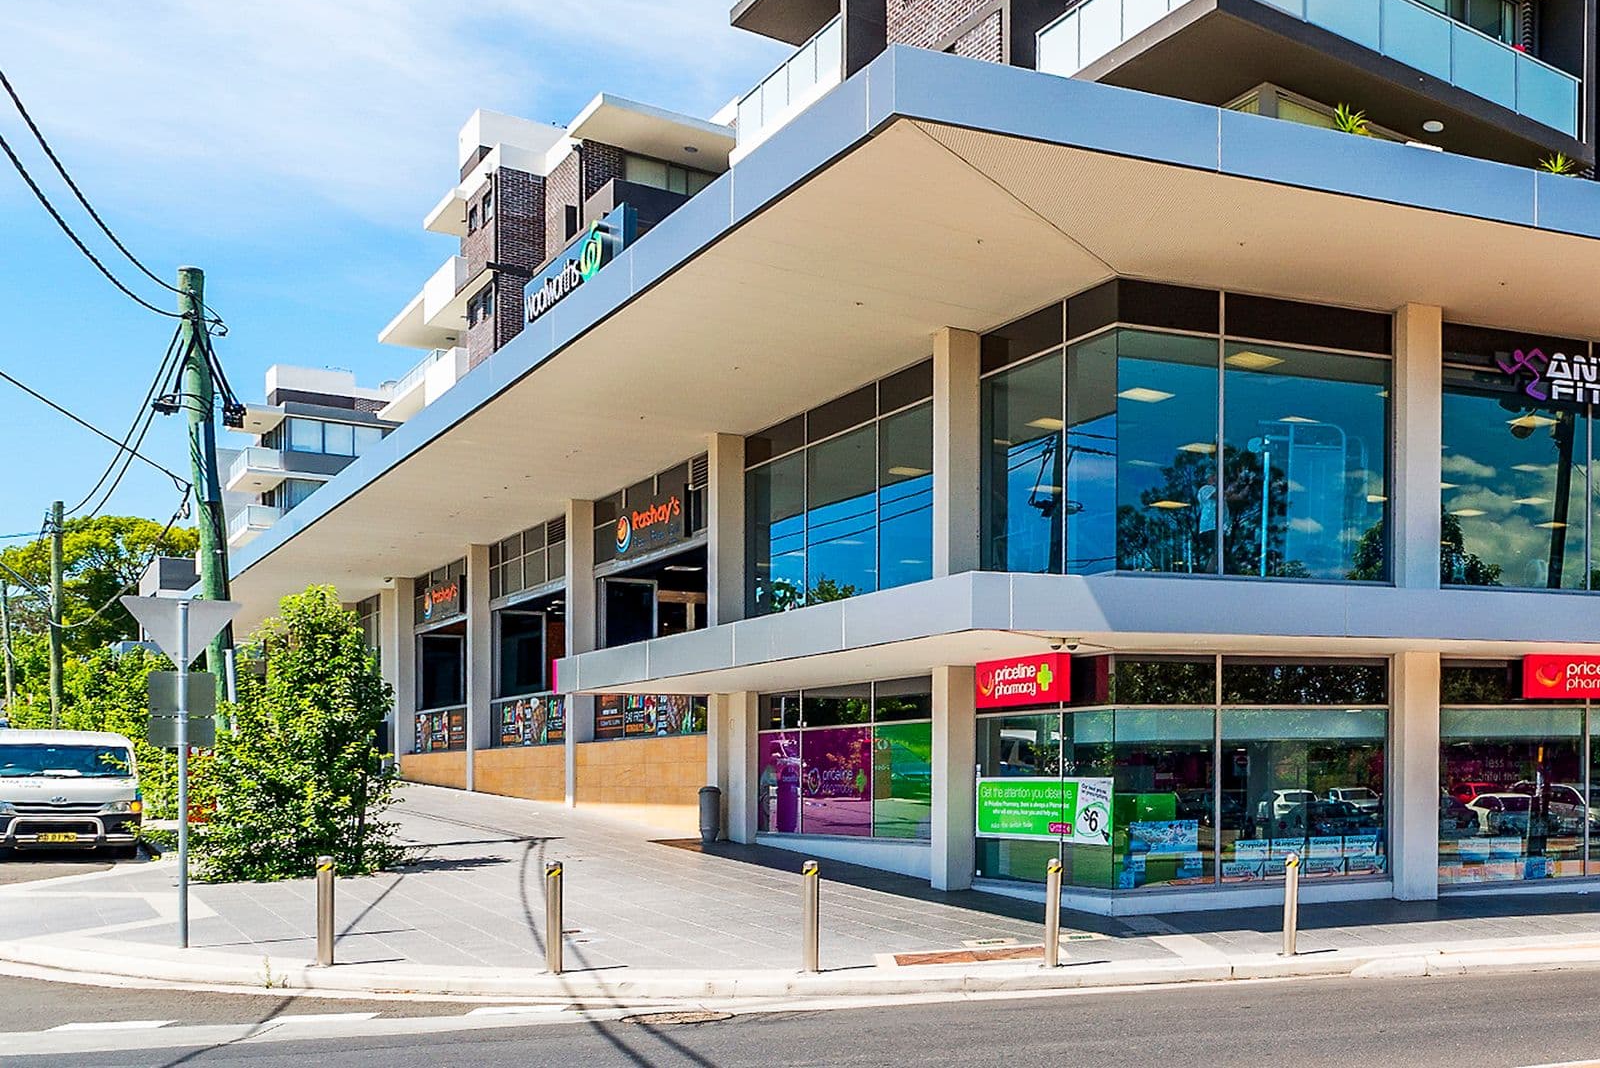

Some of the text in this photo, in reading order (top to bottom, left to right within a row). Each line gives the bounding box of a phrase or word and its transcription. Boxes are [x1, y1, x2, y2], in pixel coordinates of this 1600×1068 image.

[526, 258, 580, 320] Woolworths
[994, 663, 1036, 685] priceline
[994, 682, 1036, 699] pharmacy
[1083, 807, 1098, 832] $6
